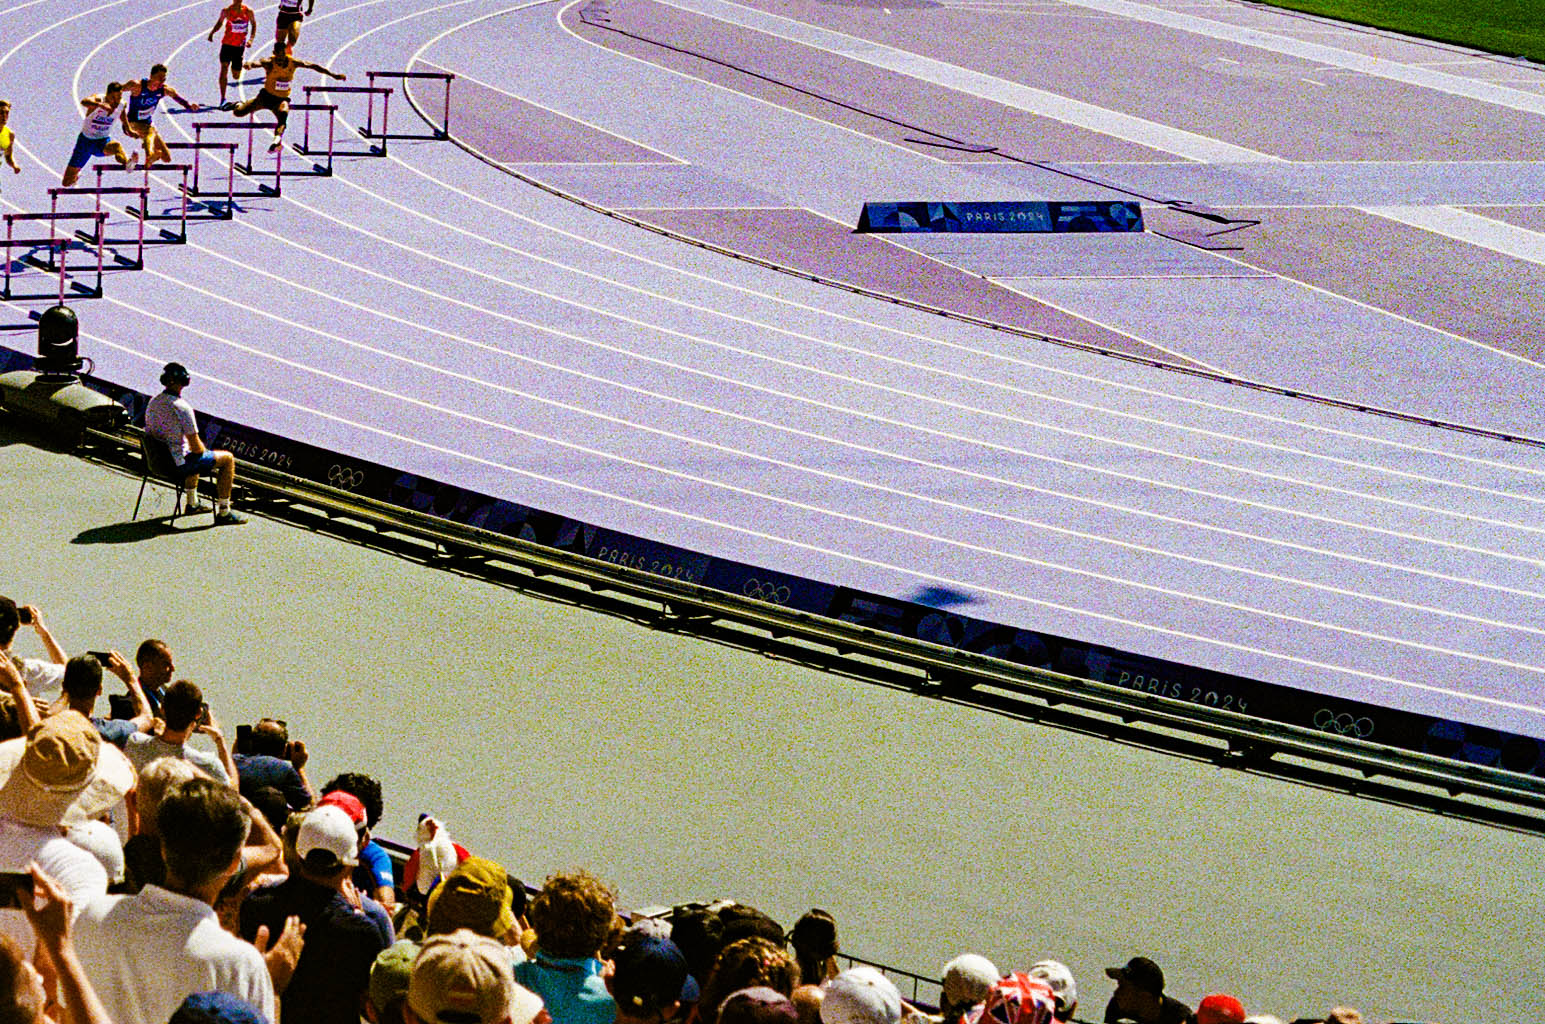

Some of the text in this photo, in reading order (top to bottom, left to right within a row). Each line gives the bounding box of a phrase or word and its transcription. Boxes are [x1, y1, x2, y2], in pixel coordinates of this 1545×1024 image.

[966, 211, 1044, 223] PARIS 2024
[222, 436, 294, 469] PARIS 2024
[598, 546, 646, 570] PARIS
[1118, 671, 1249, 713] PARIS 2024
